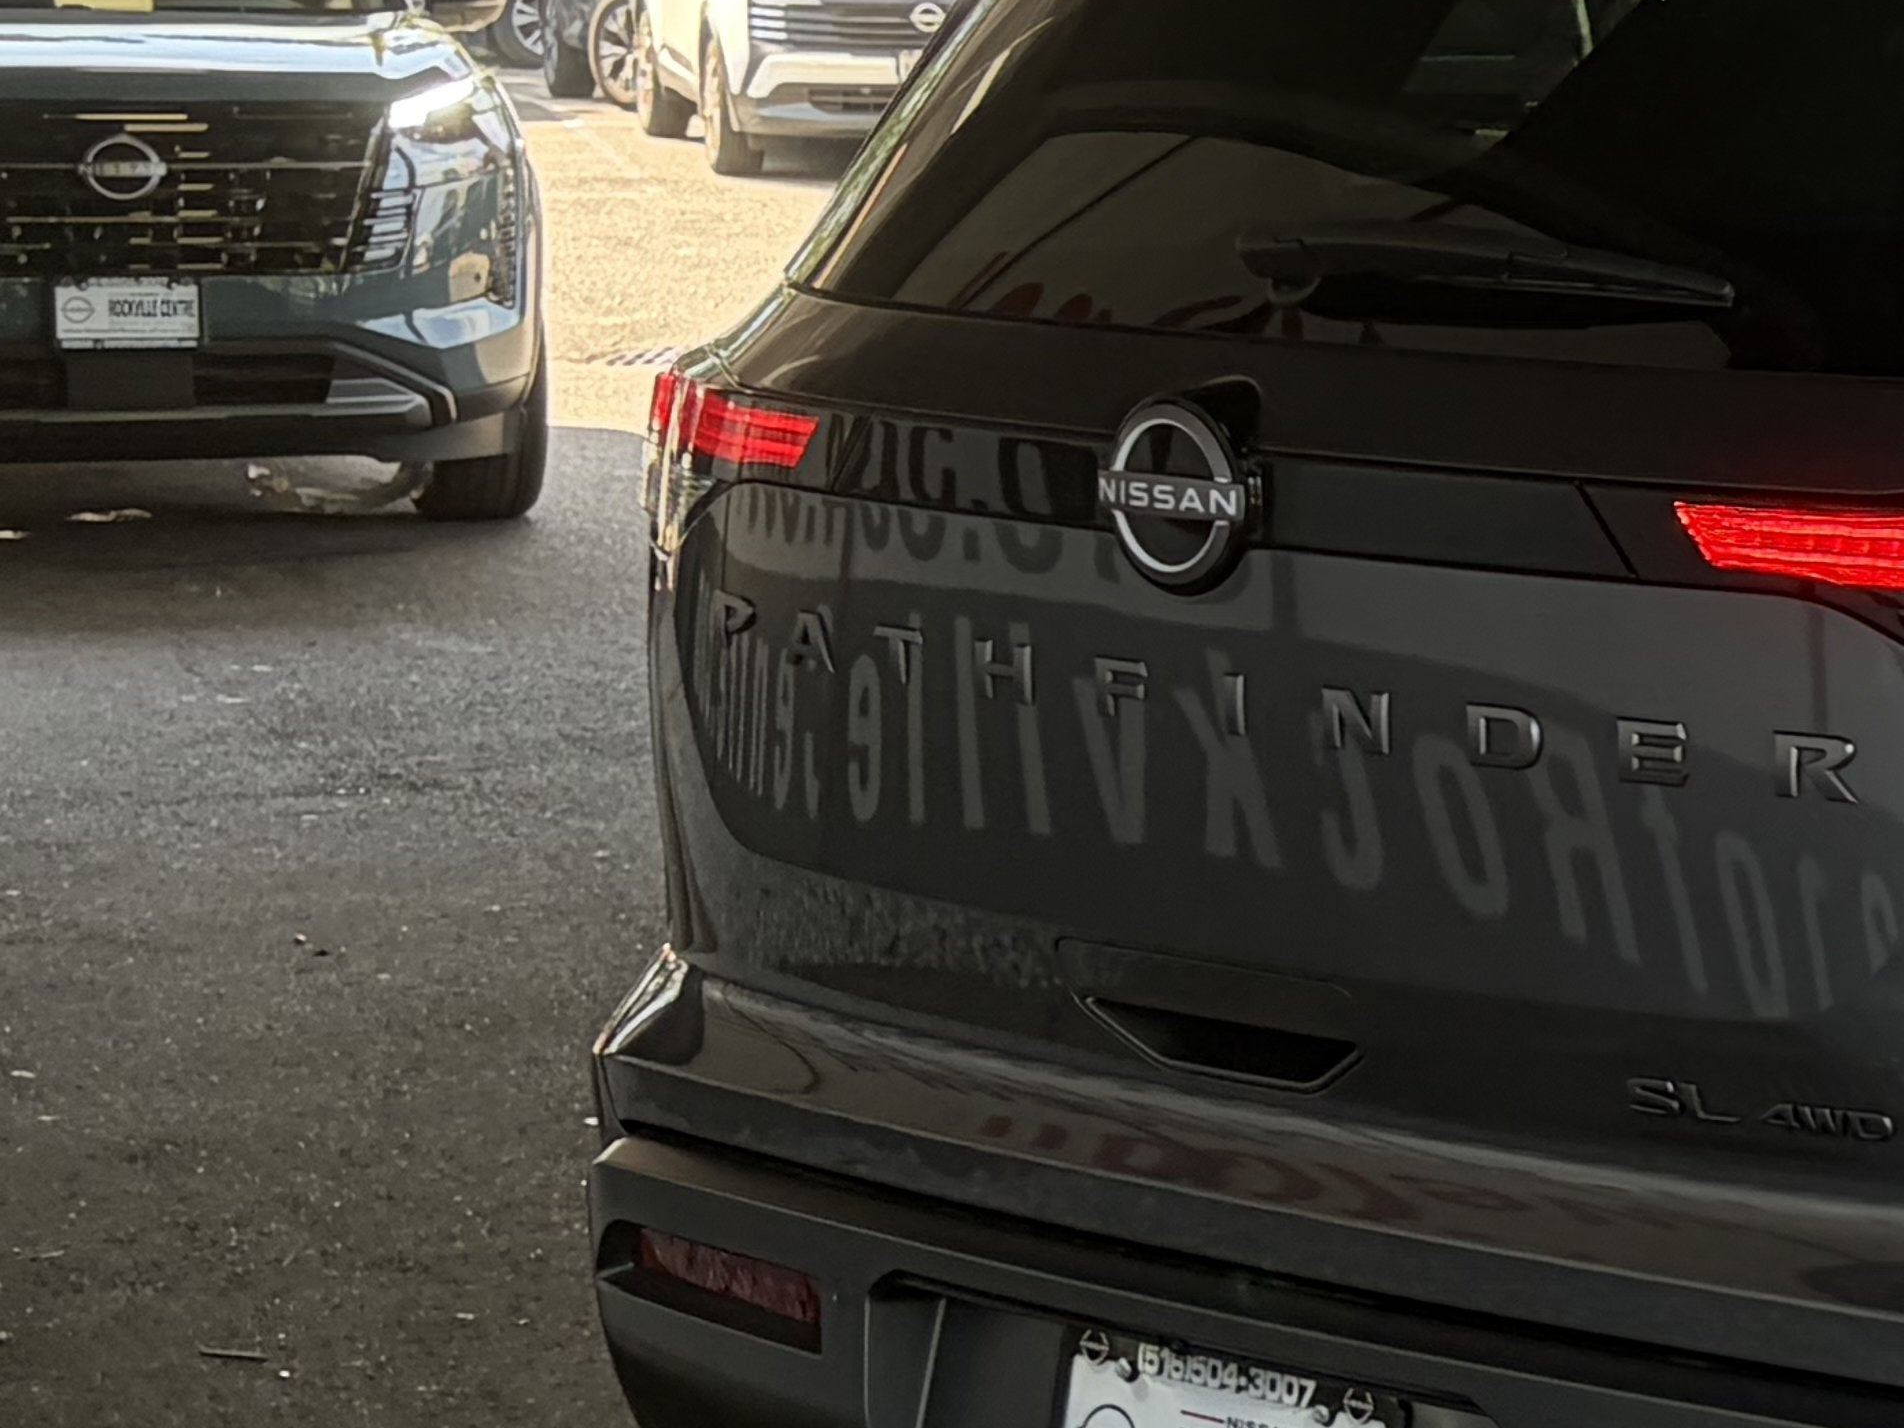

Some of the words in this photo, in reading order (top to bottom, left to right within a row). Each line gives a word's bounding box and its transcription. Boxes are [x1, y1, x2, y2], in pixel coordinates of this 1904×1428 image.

[1098, 476, 1238, 516] NISSAN
[714, 588, 1864, 808] PATHFINDER
[1625, 1076, 1743, 1125] SL
[1765, 1100, 1898, 1144] 4WD
